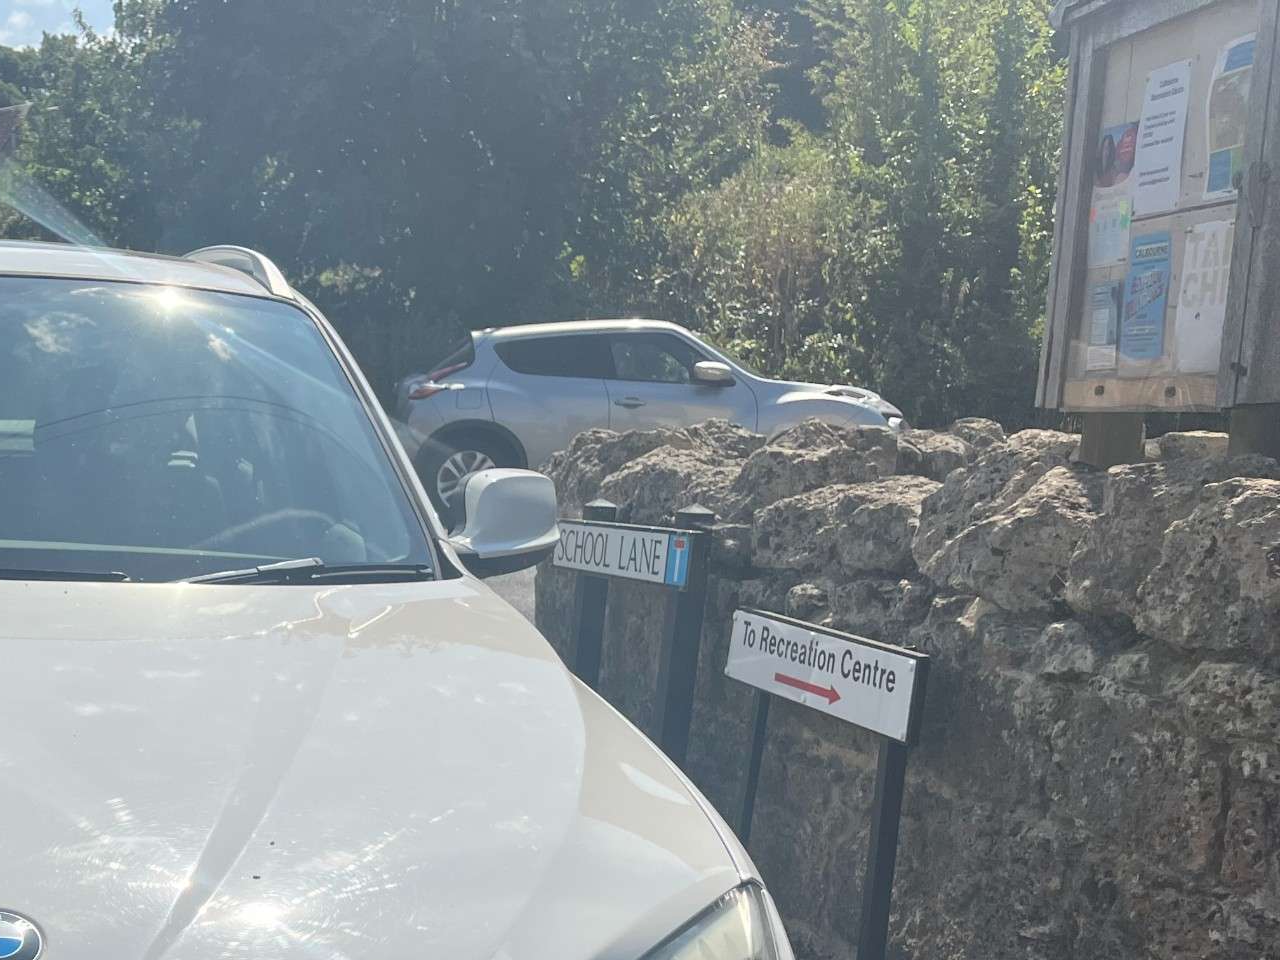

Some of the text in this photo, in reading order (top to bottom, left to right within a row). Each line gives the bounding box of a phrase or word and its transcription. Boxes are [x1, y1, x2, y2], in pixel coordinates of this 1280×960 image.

[558, 529, 662, 575] SCHOOL LANE
[743, 620, 896, 693] To Recreation Centre
